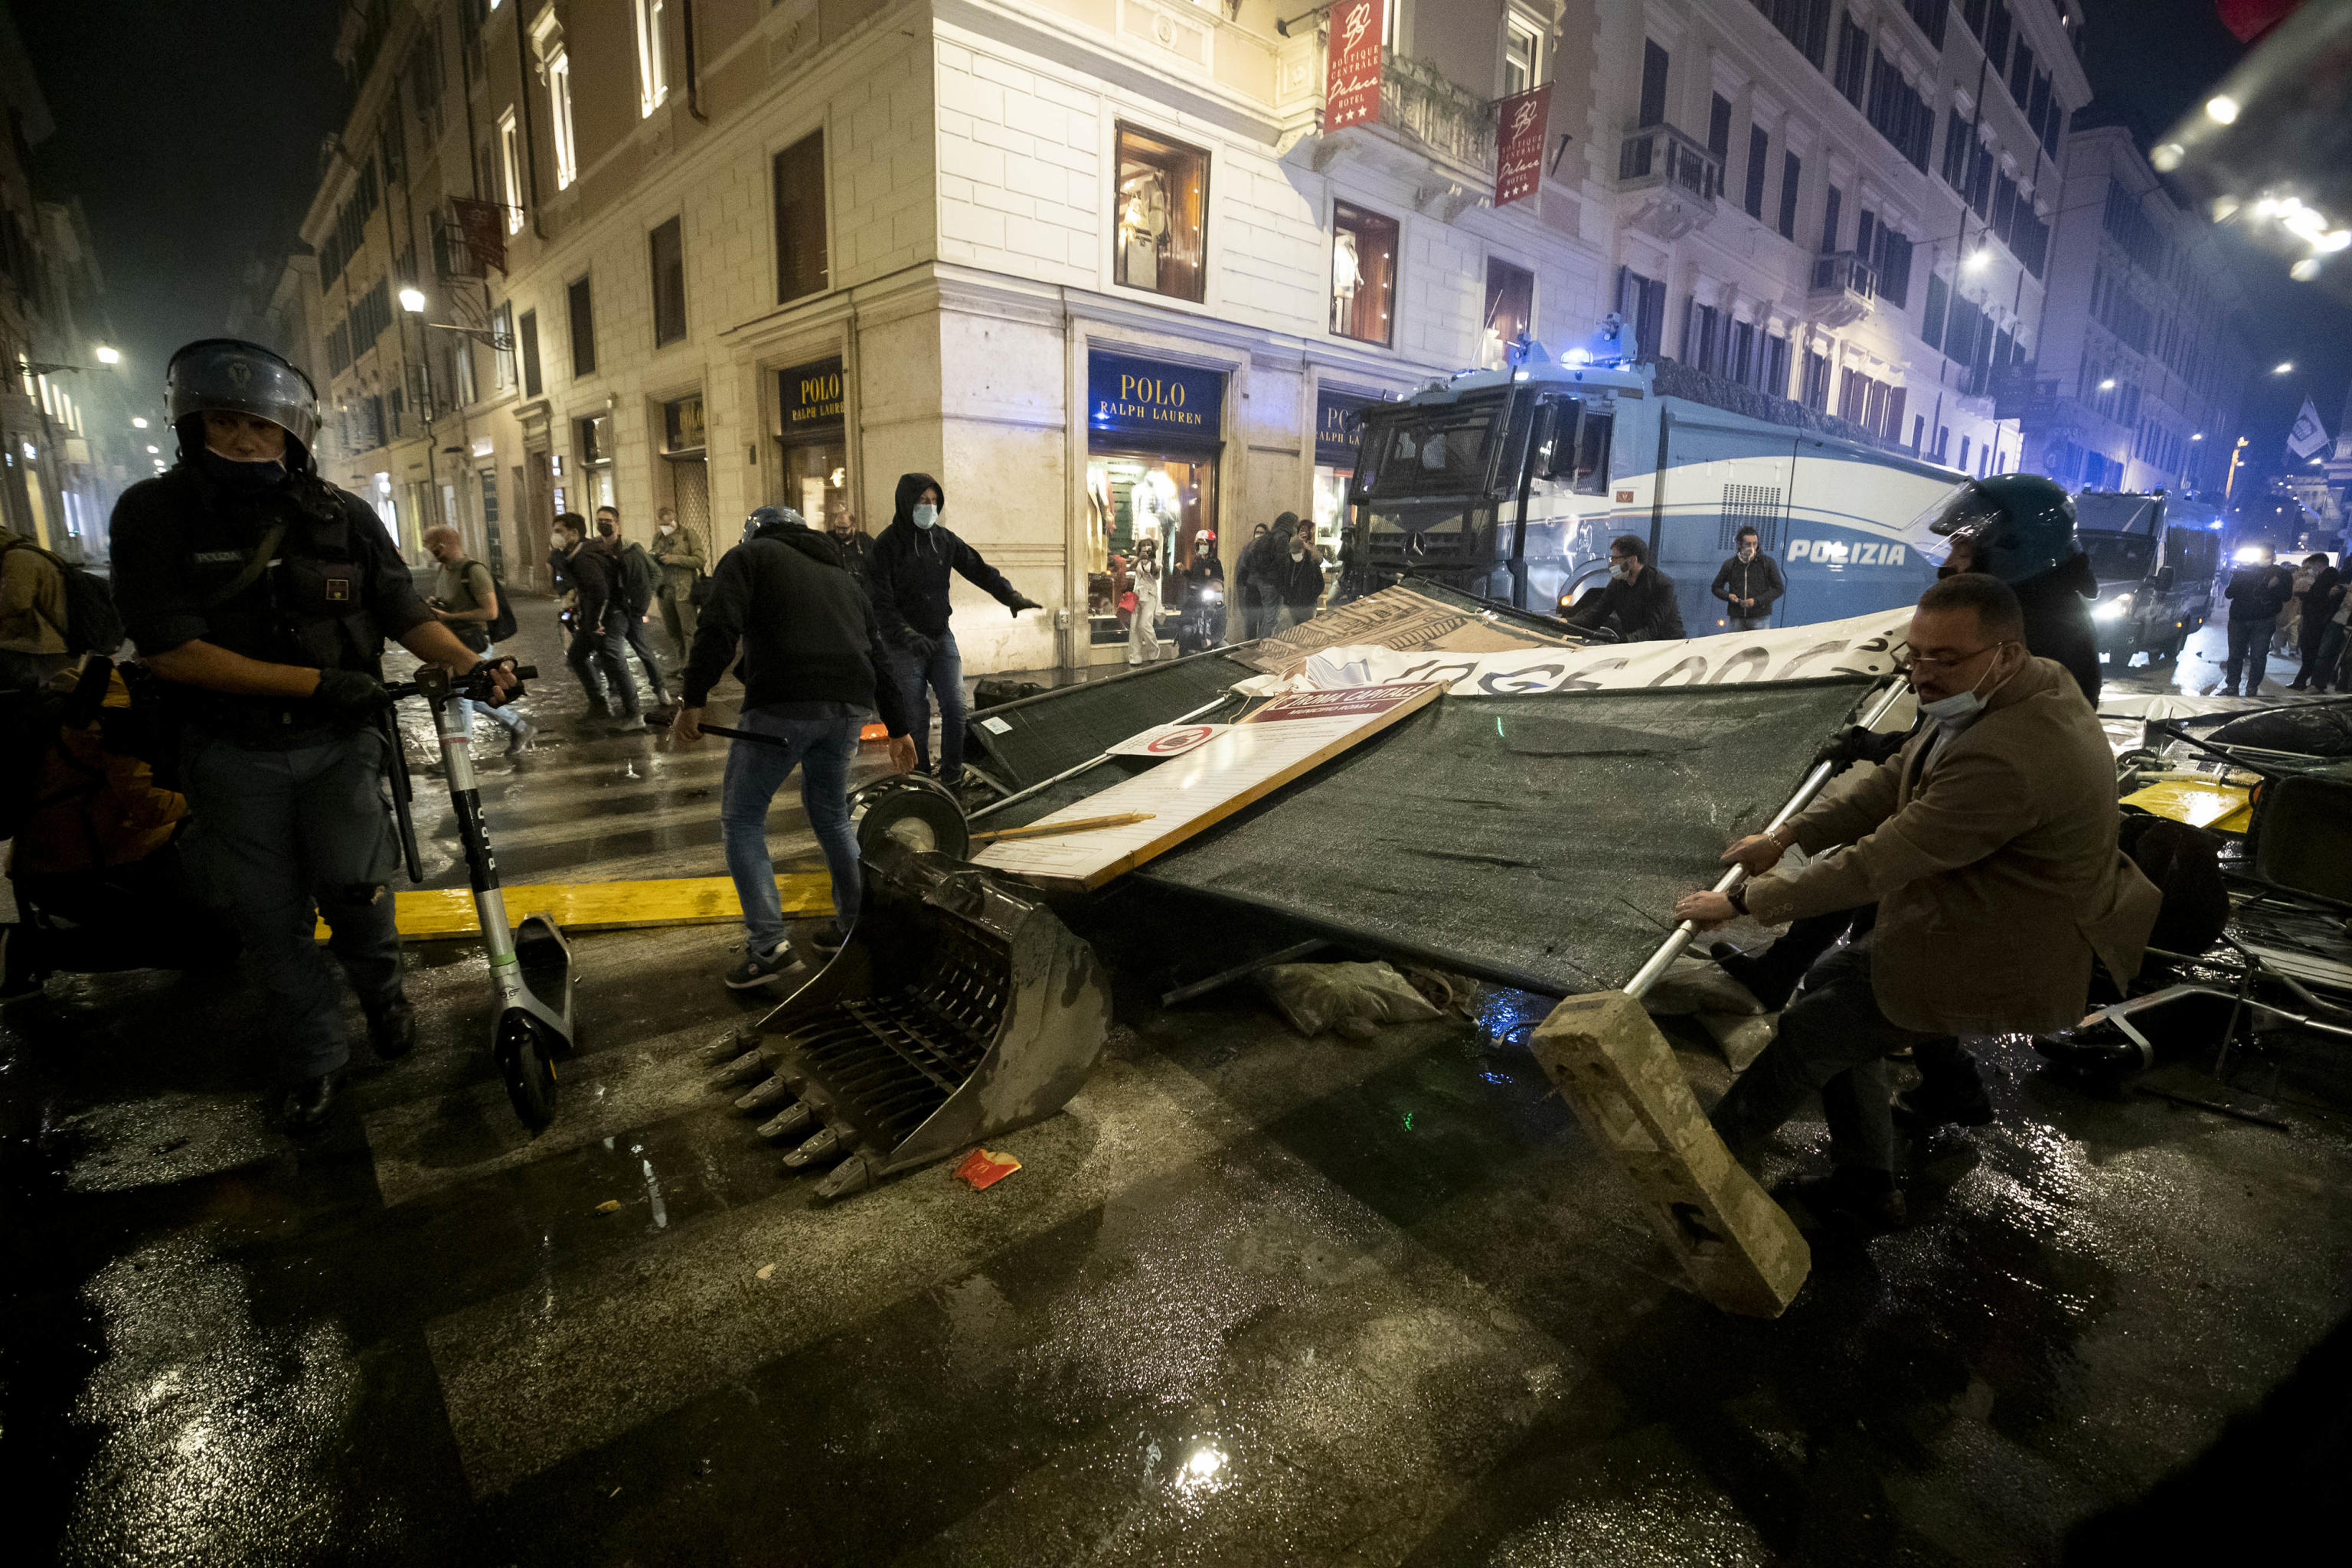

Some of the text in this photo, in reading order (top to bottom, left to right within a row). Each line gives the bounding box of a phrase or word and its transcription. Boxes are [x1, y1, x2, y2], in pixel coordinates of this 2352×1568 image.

[1331, 56, 1379, 80] CENTRALE
[1332, 44, 1379, 69] BOUTIQUE
[1328, 76, 1379, 105] Palace
[1338, 93, 1364, 109] HOTEL
[1498, 158, 1540, 183] Palace
[1507, 173, 1527, 186] HOTEL
[801, 373, 839, 404] POLO
[1121, 374, 1185, 407] POLO
[792, 407, 816, 421] RALPH
[1100, 400, 1202, 425] RALPH LAUREN
[1316, 430, 1344, 443] ALPH
[1786, 539, 1906, 566] POLIZIA
[1292, 685, 1428, 706] ROMA CAPITALE
[1287, 706, 1339, 716] MUNICIPIO
[1337, 703, 1370, 711] ROMA
